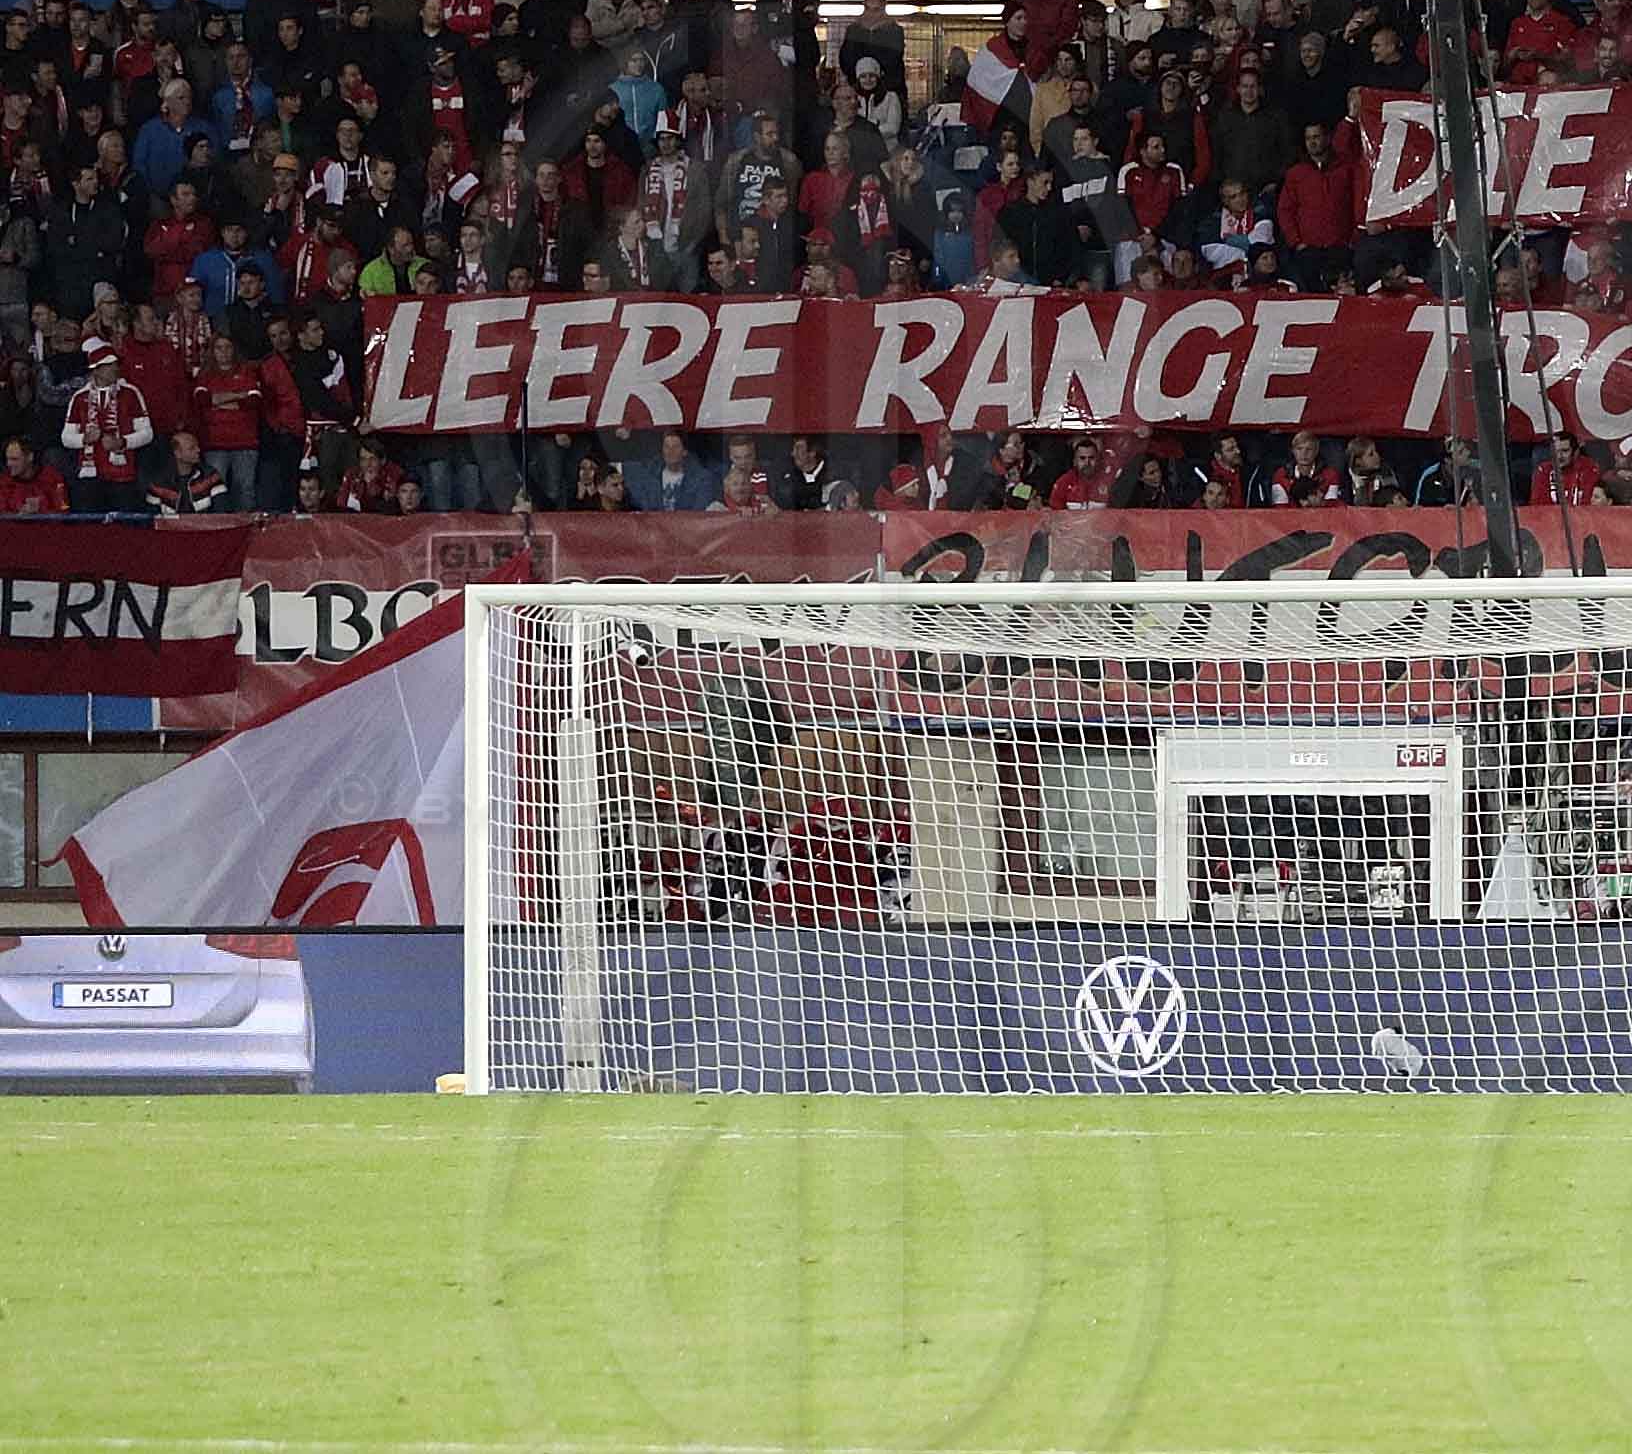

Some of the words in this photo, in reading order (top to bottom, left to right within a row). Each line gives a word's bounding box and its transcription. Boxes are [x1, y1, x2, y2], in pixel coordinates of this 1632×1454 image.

[1366, 87, 1612, 223] DIE
[369, 295, 803, 431] LEERE
[1397, 746, 1446, 765] ORF
[81, 988, 151, 1002] PASSAT
